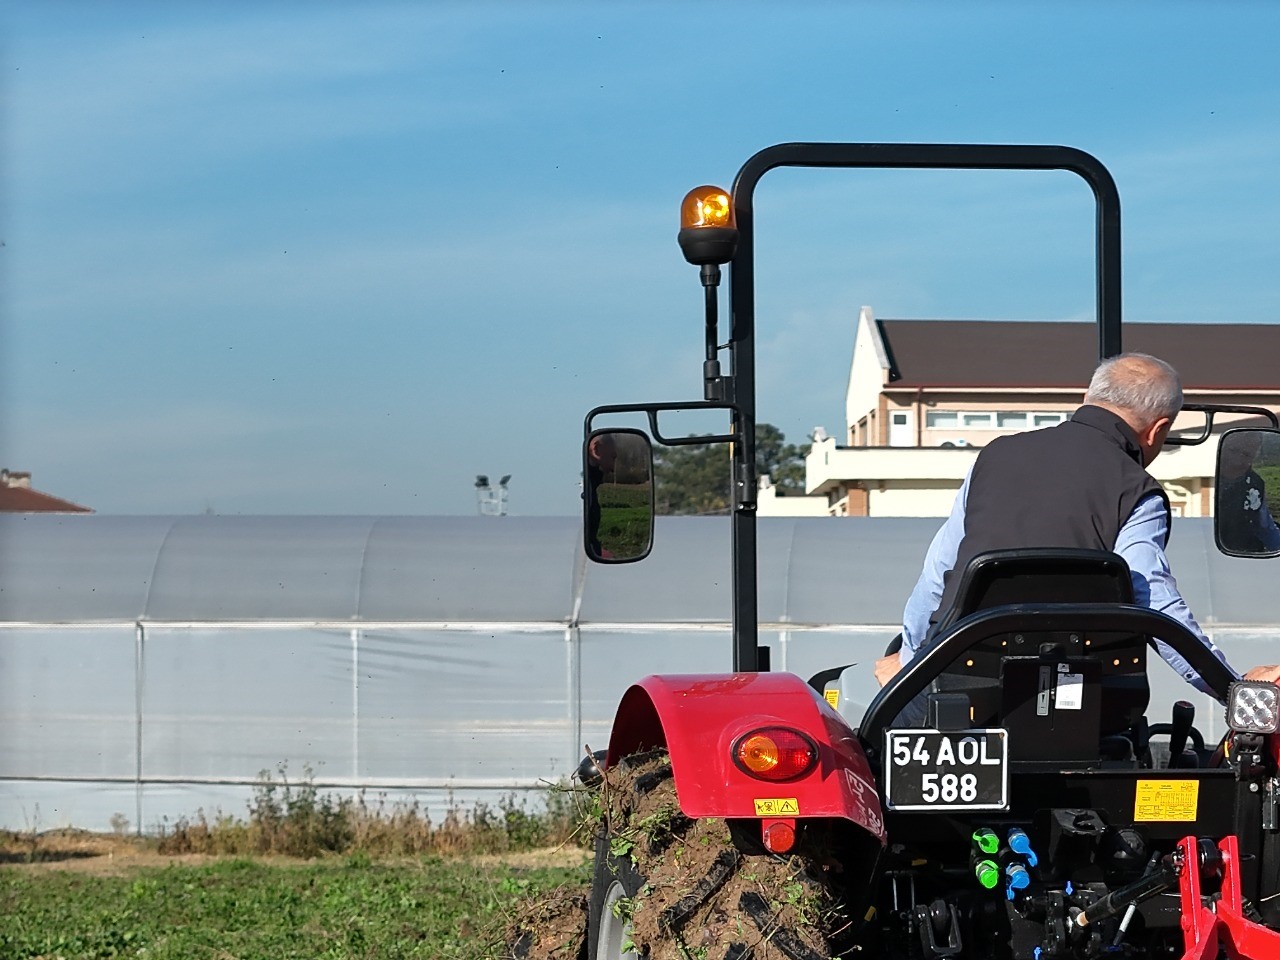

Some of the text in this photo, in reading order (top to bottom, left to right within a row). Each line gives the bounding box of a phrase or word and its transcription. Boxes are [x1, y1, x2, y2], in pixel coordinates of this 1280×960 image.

[893, 736, 1000, 766] 54 AOL
[922, 773, 977, 803] 588
